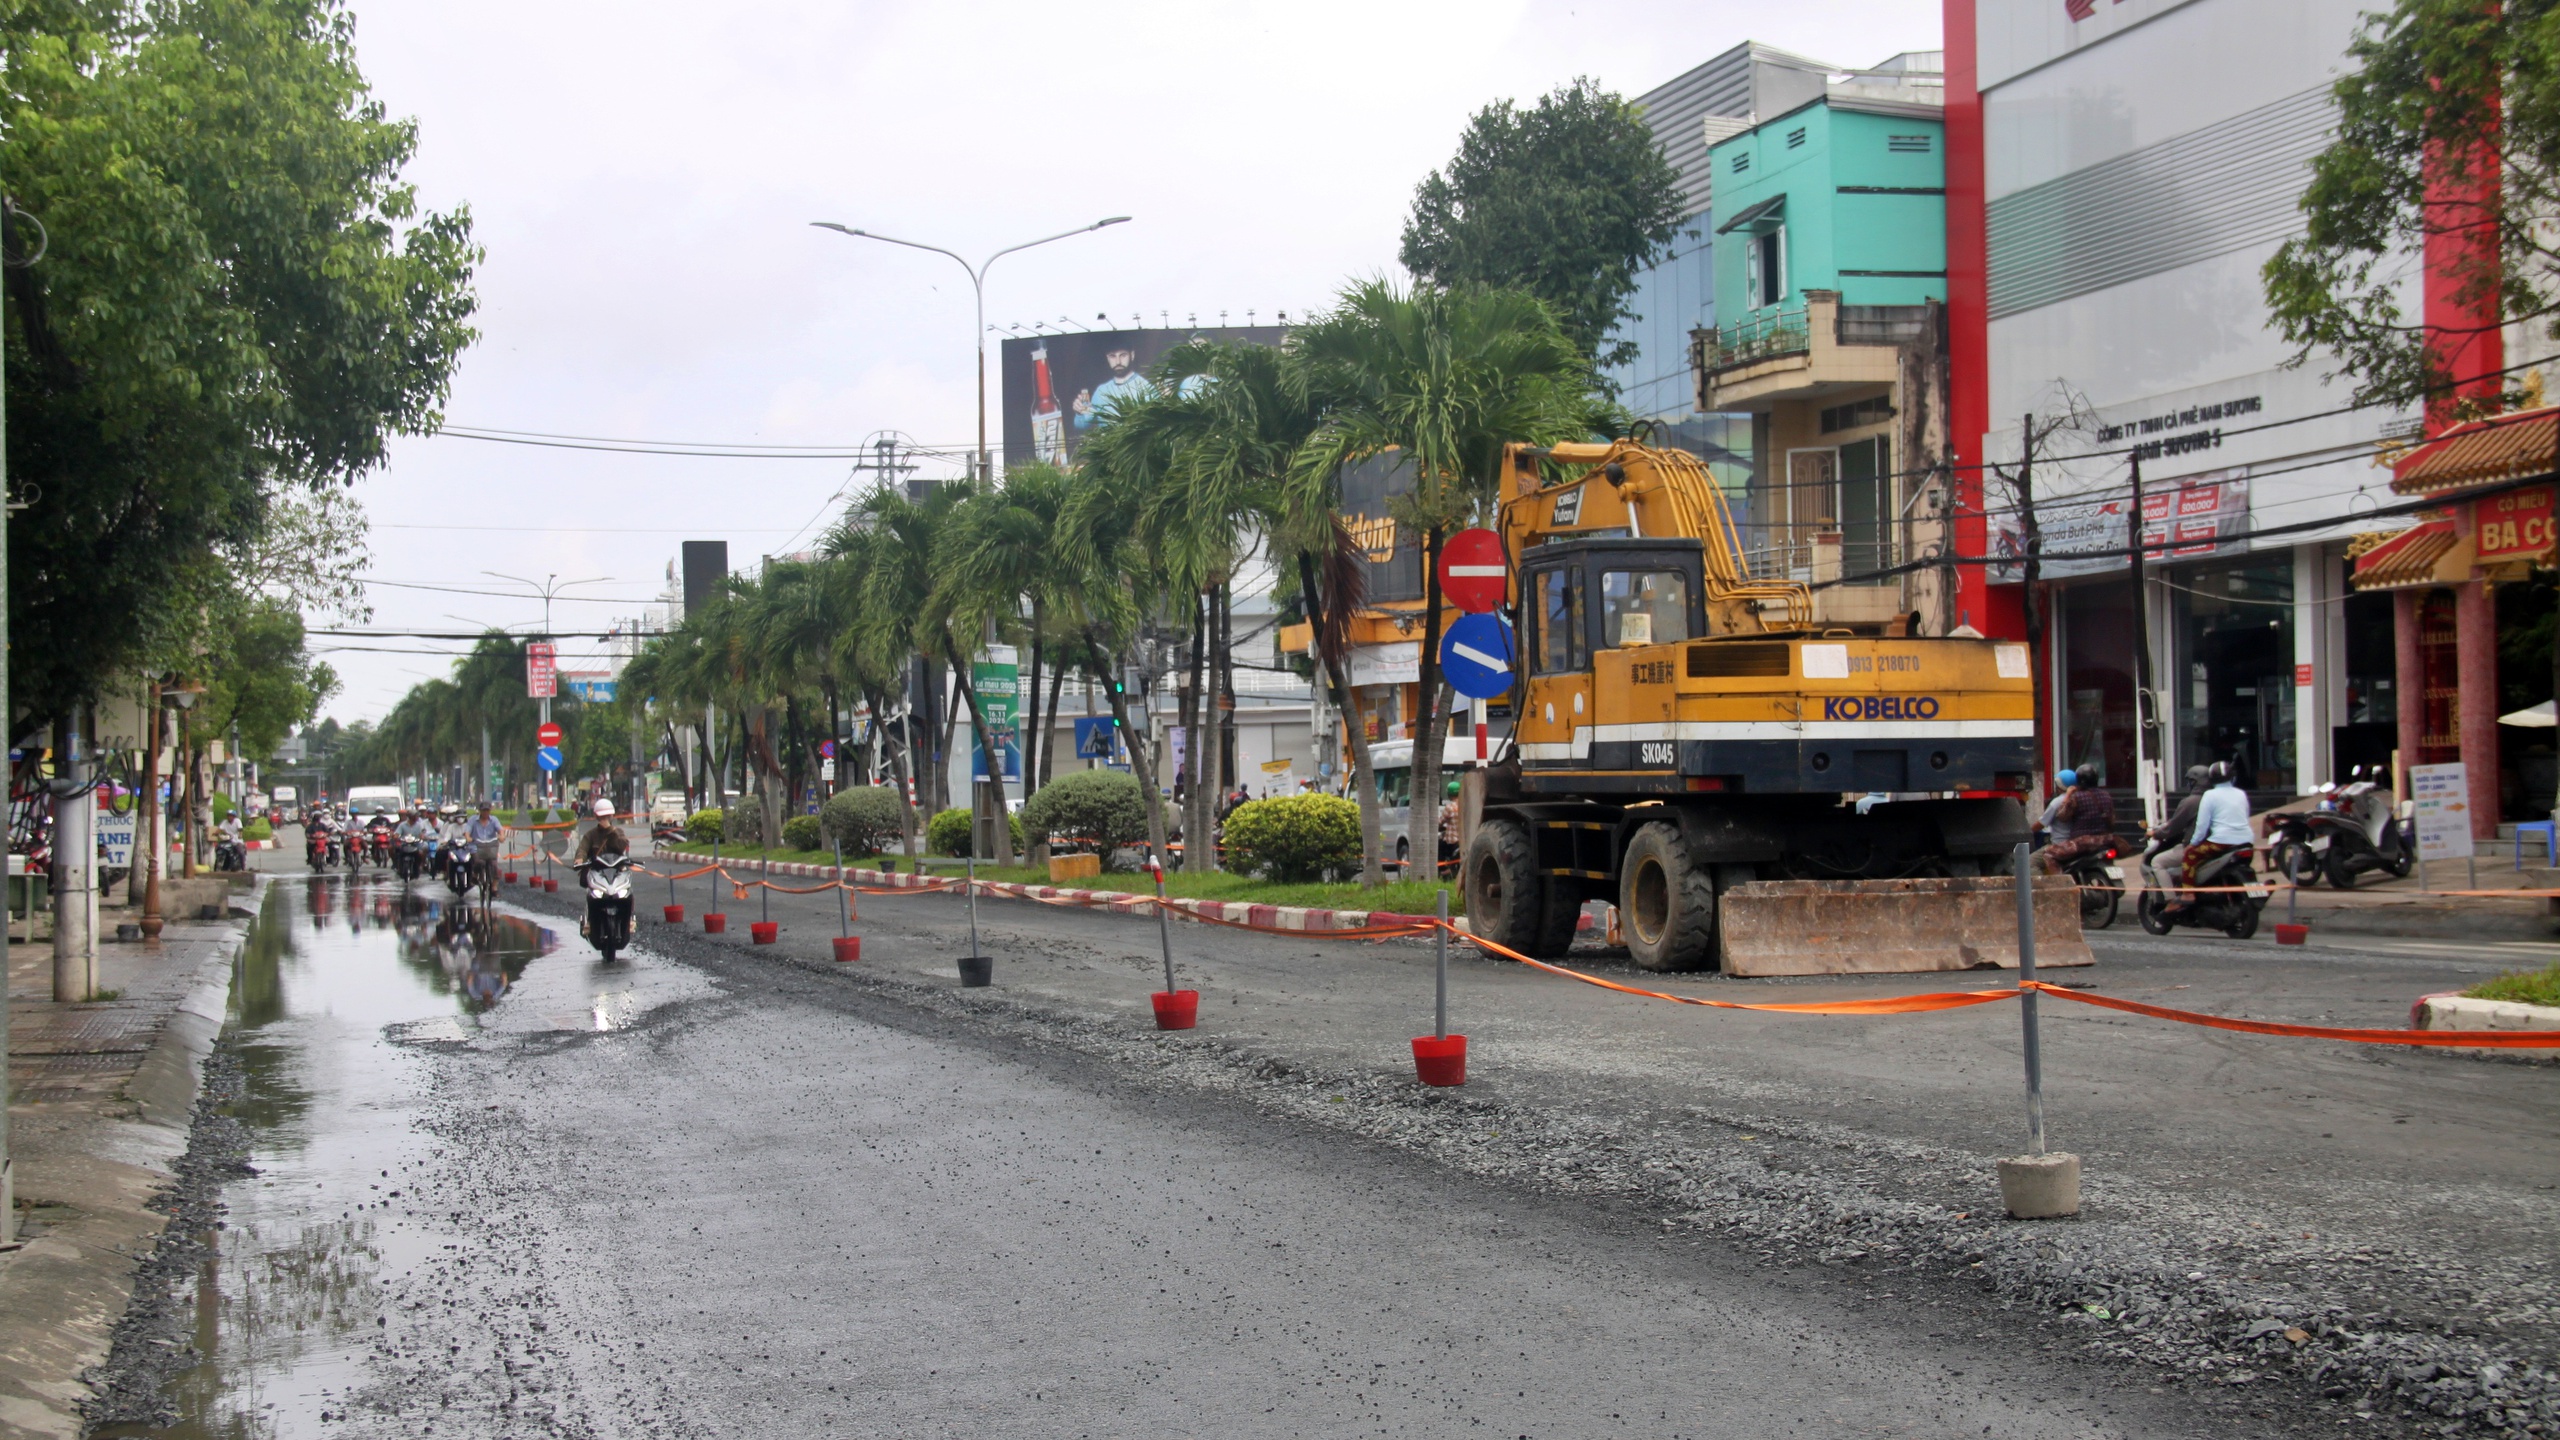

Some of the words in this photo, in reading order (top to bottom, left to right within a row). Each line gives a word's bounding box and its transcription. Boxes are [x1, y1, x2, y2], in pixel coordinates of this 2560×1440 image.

[2097, 424, 2123, 443] CÔNG
[2124, 423, 2137, 438] TY
[2200, 403, 2222, 422] NAM
[2040, 527, 2068, 545] onda
[1848, 657, 1873, 673] 0913
[1878, 655, 1920, 672] 218070
[1824, 697, 1939, 720] KOBELCO
[1642, 742, 1674, 765] SK045
